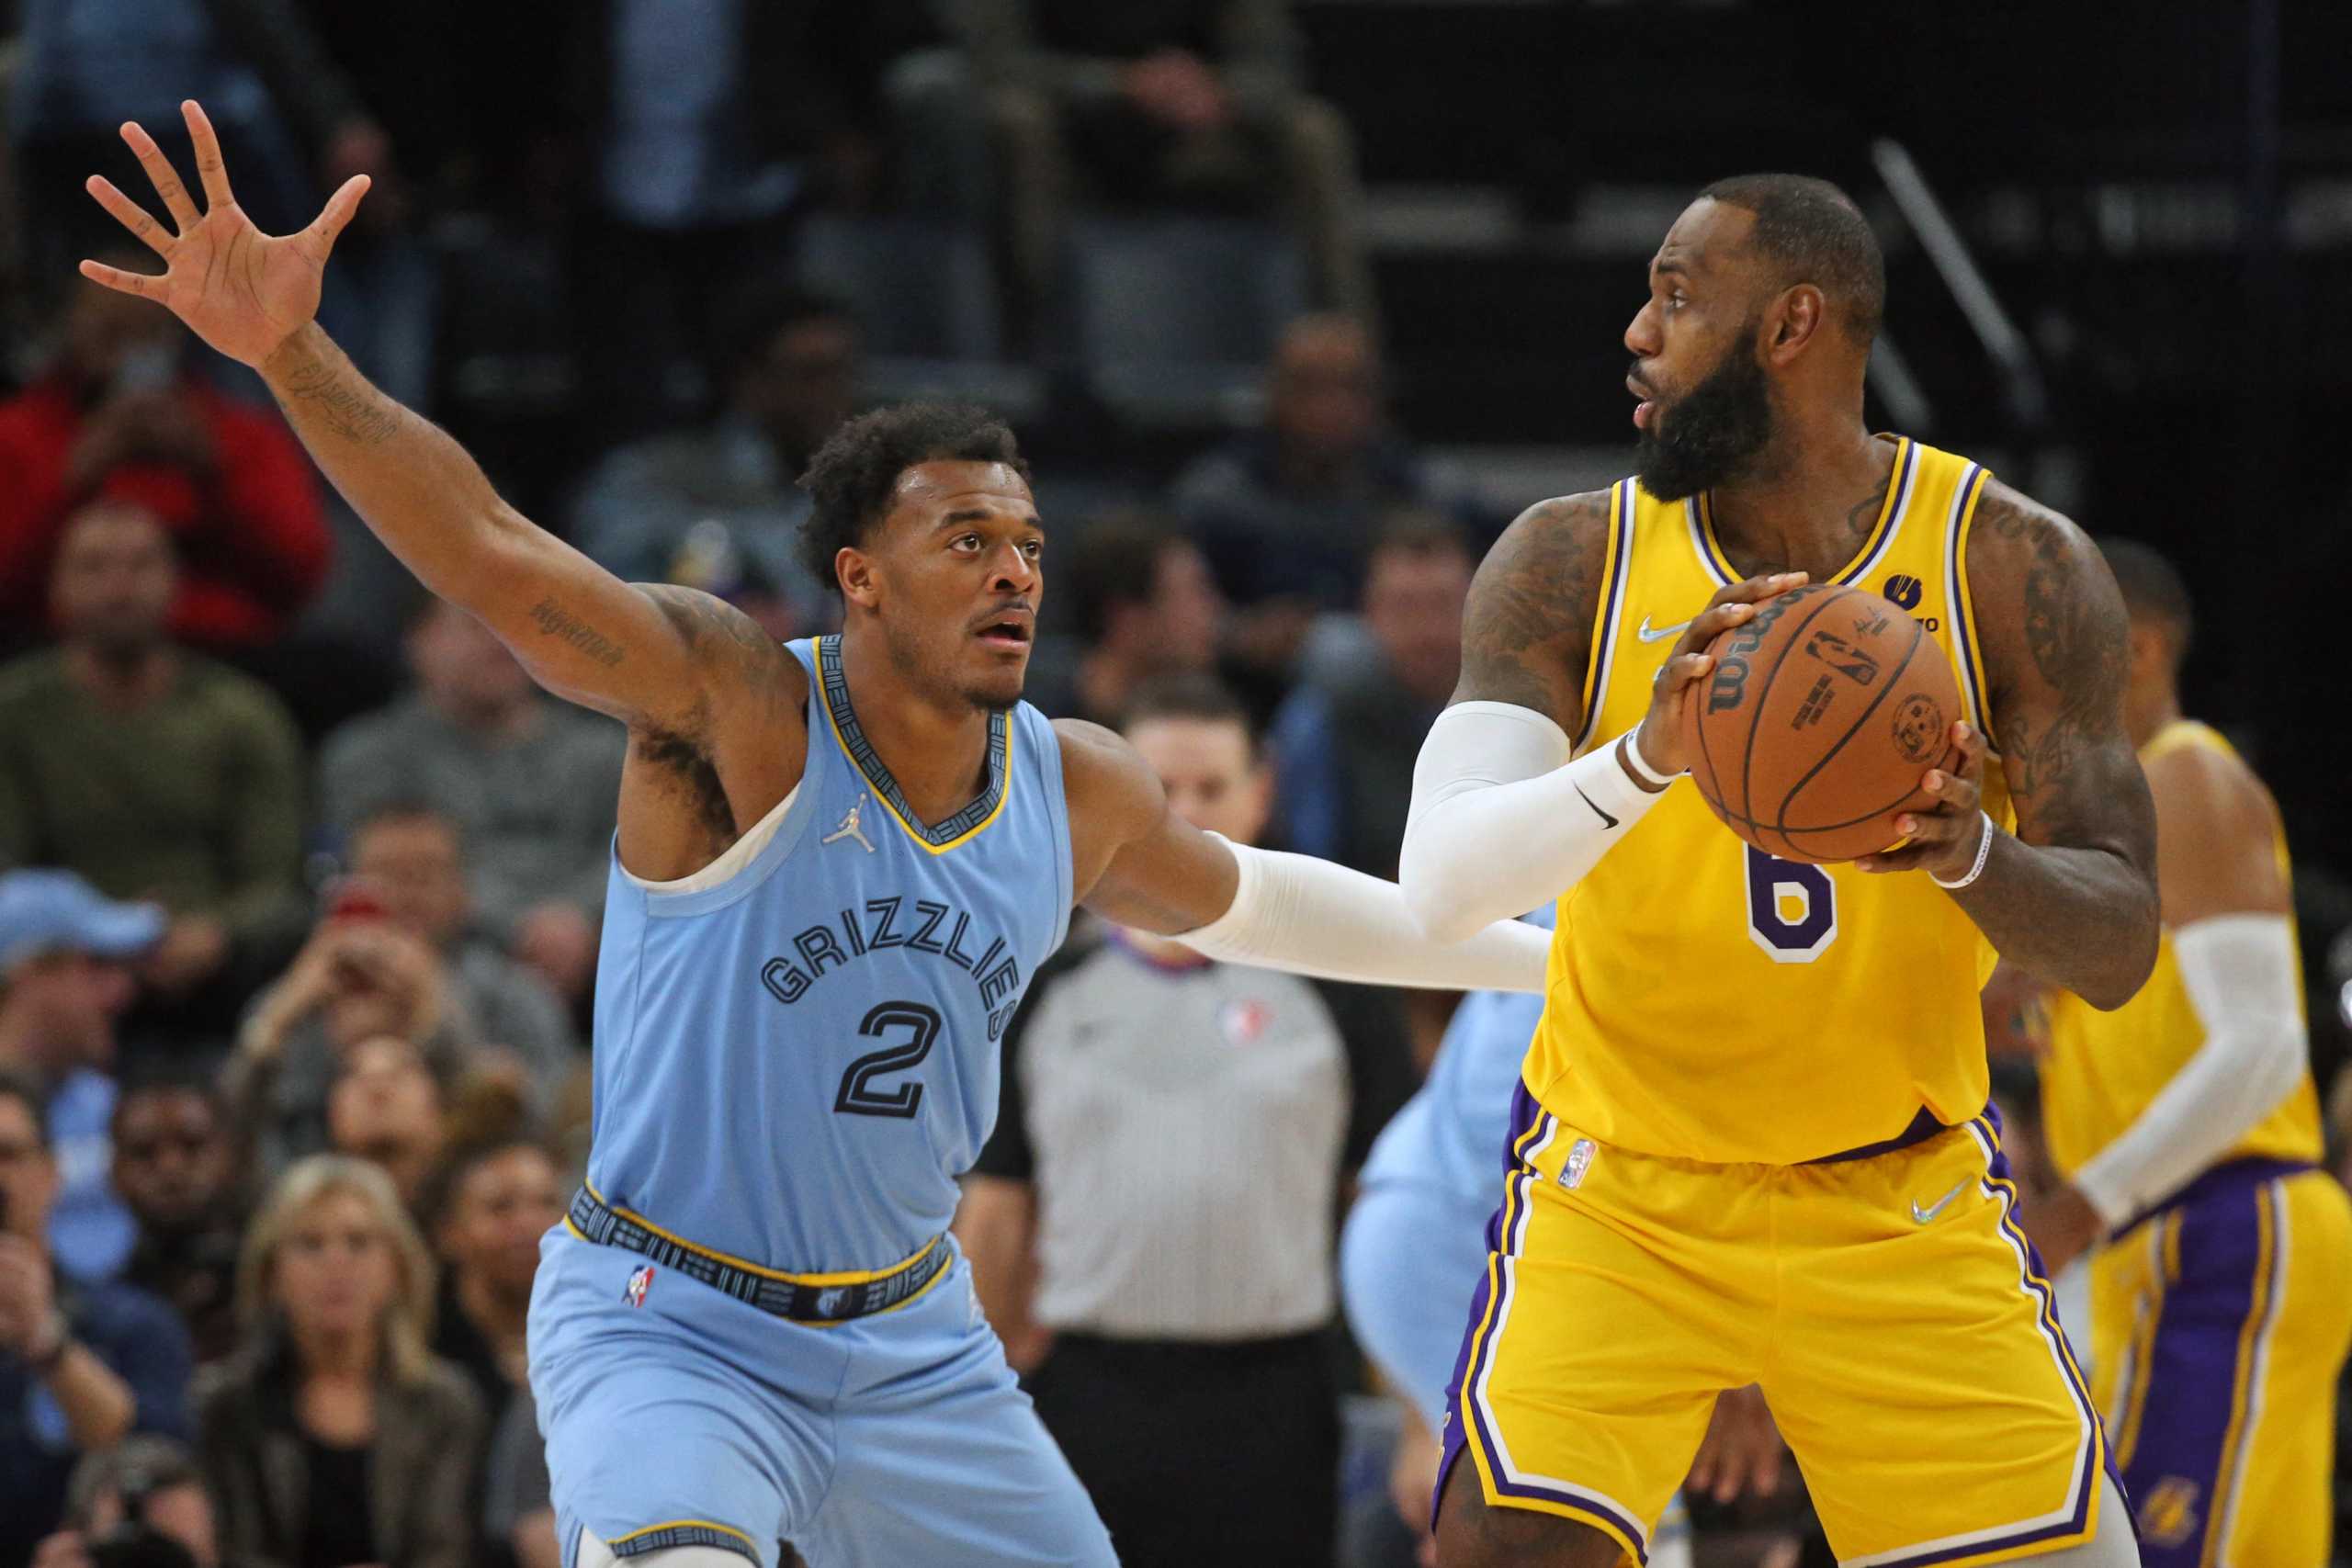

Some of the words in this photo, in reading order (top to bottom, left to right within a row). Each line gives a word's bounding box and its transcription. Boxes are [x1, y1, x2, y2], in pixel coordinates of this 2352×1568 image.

[1743, 840, 1838, 963] 6
[762, 897, 1020, 1042] GRIZZLIES
[834, 1000, 941, 1118] 2
